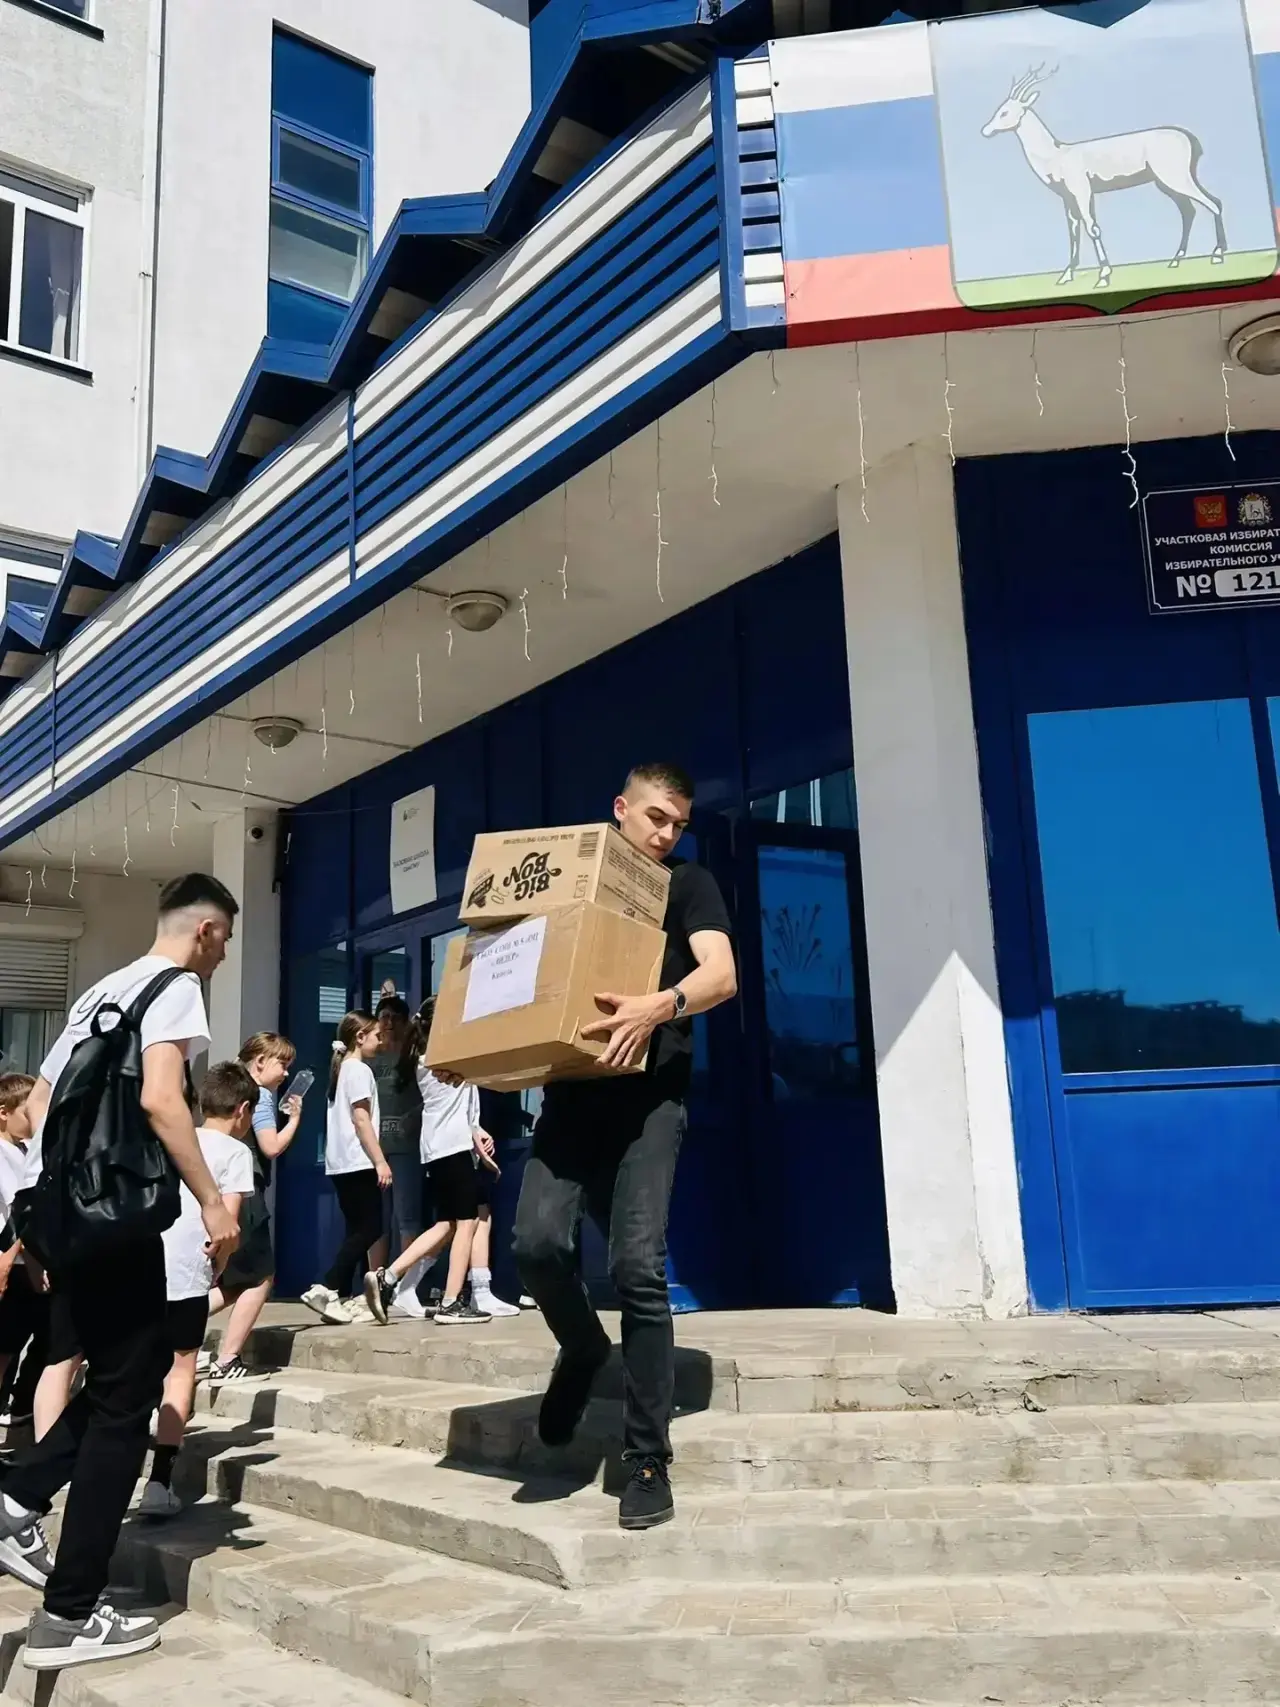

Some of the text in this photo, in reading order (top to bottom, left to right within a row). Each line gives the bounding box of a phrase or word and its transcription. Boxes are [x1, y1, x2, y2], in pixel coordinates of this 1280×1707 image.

[1154, 532, 1227, 546] УЧАСТКОВАЯ
[1210, 541, 1273, 555] КОМИССИЯ
[1165, 554, 1268, 571] ИЗБИРАТЕЛЬНОГО
